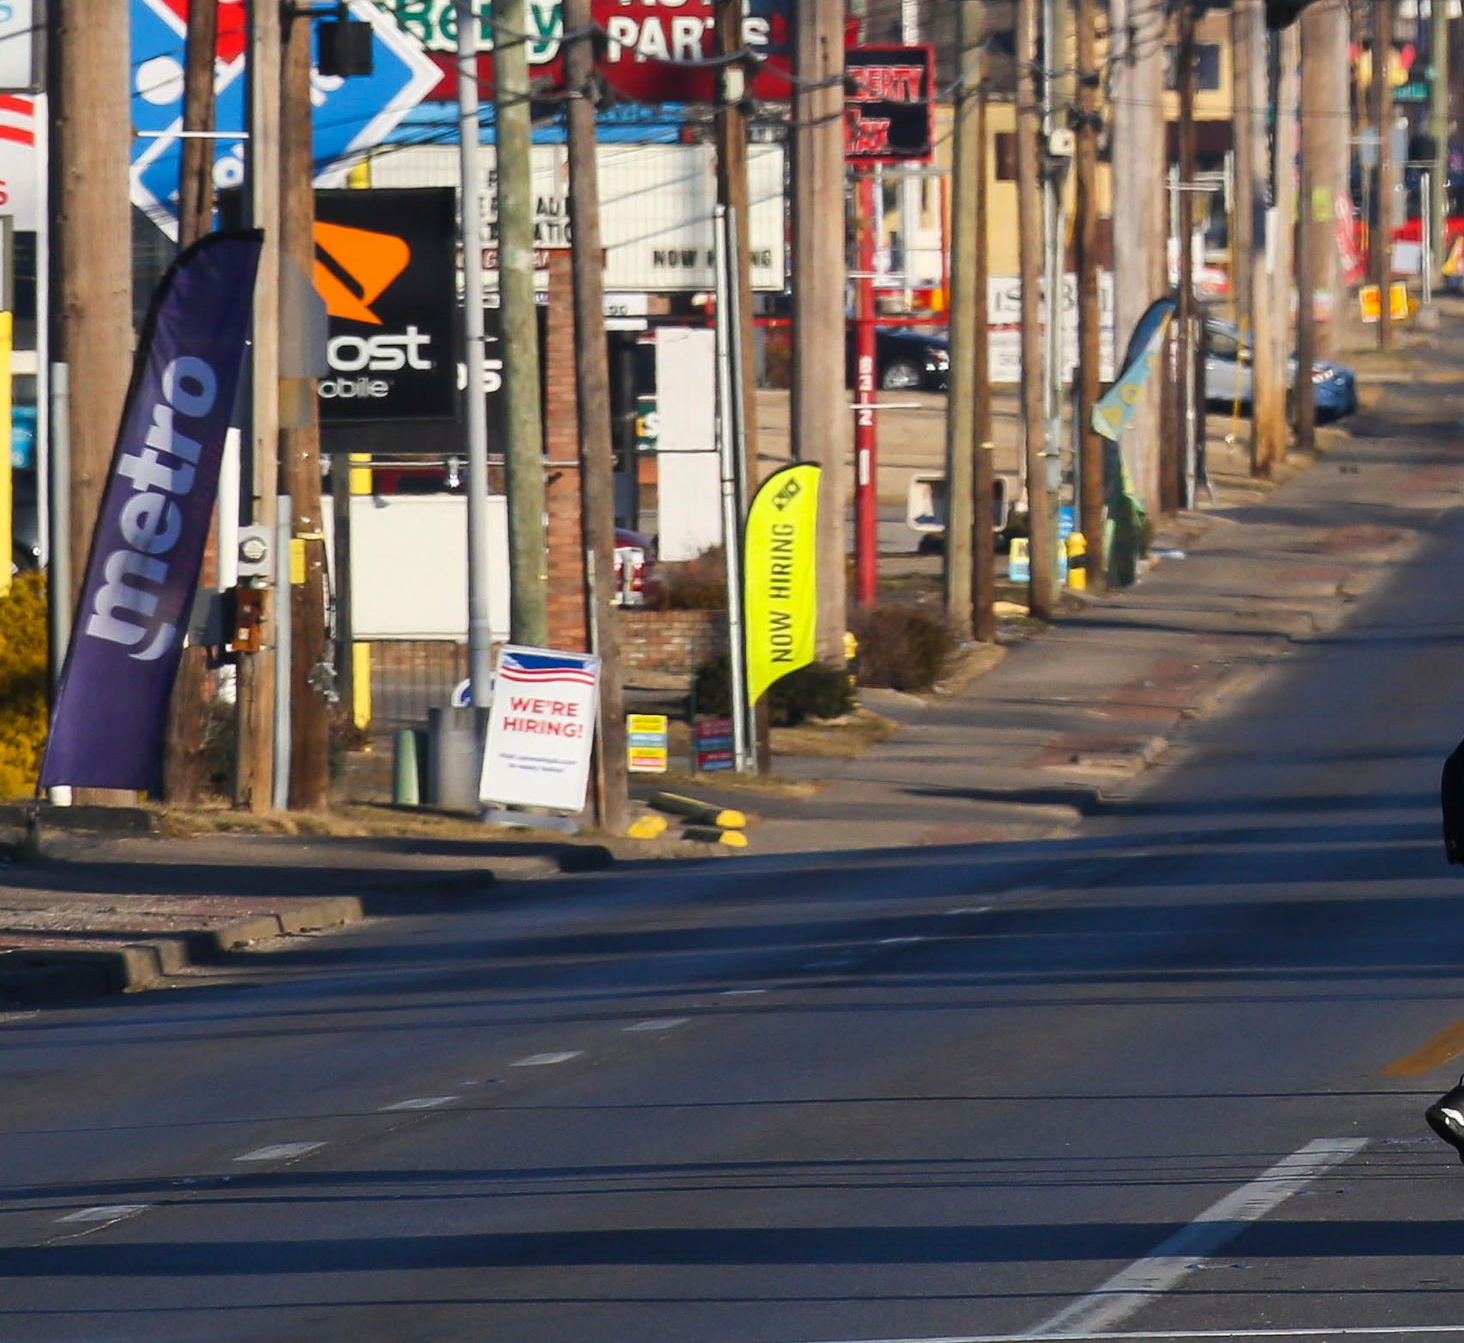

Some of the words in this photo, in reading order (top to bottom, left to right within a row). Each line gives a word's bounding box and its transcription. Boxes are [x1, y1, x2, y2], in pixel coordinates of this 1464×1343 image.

[607, 15, 771, 64] PARS
[653, 249, 698, 268] NOW
[326, 324, 432, 372] ost
[317, 376, 389, 399] obile
[86, 355, 218, 662] metro
[769, 523, 796, 600] HIRING
[769, 610, 794, 664] NOW
[502, 716, 585, 739] HIRING!
[510, 696, 580, 718] WE'RE
